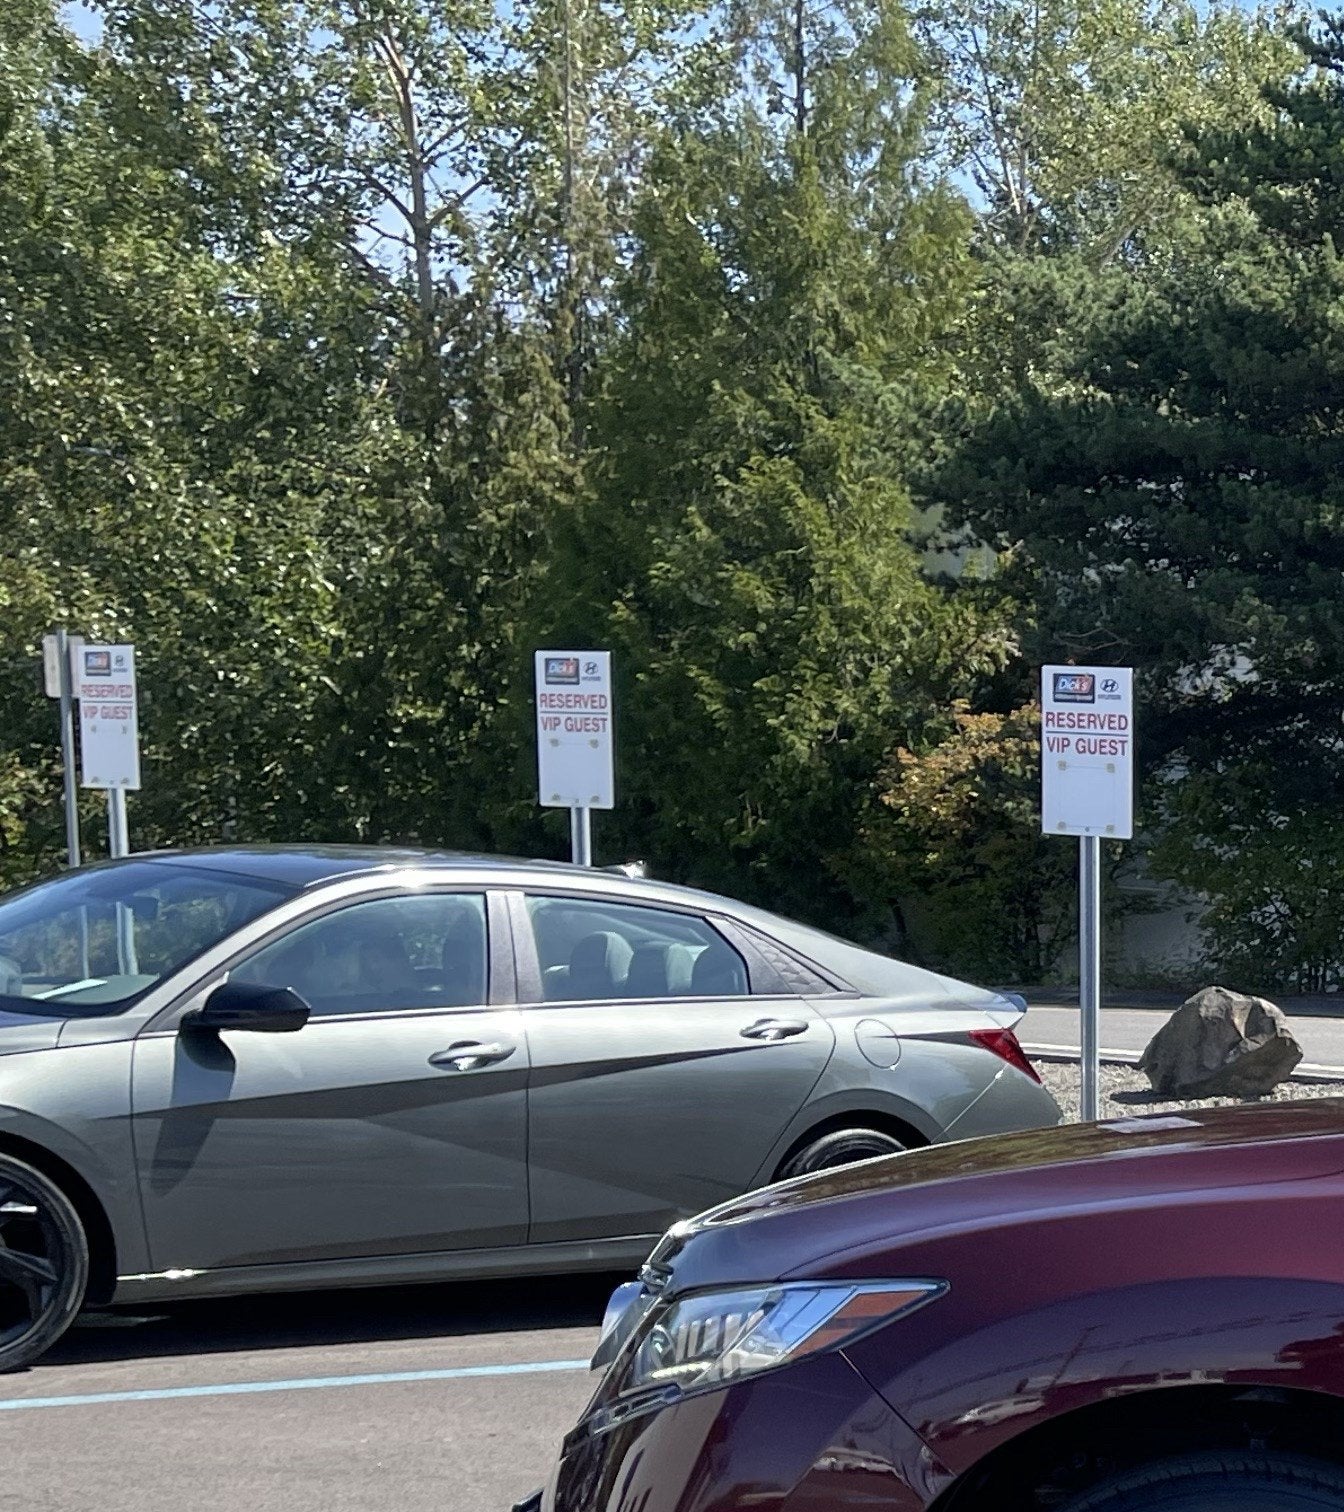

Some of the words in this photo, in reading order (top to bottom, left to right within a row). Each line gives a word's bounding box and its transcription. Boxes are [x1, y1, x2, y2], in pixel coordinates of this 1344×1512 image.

[540, 693, 607, 709] RESERVED
[541, 716, 561, 731] VIP
[564, 716, 608, 732] GUEST
[1045, 711, 1128, 731] RESERVED
[1046, 736, 1071, 753] VIP
[1075, 738, 1128, 756] GUEST
